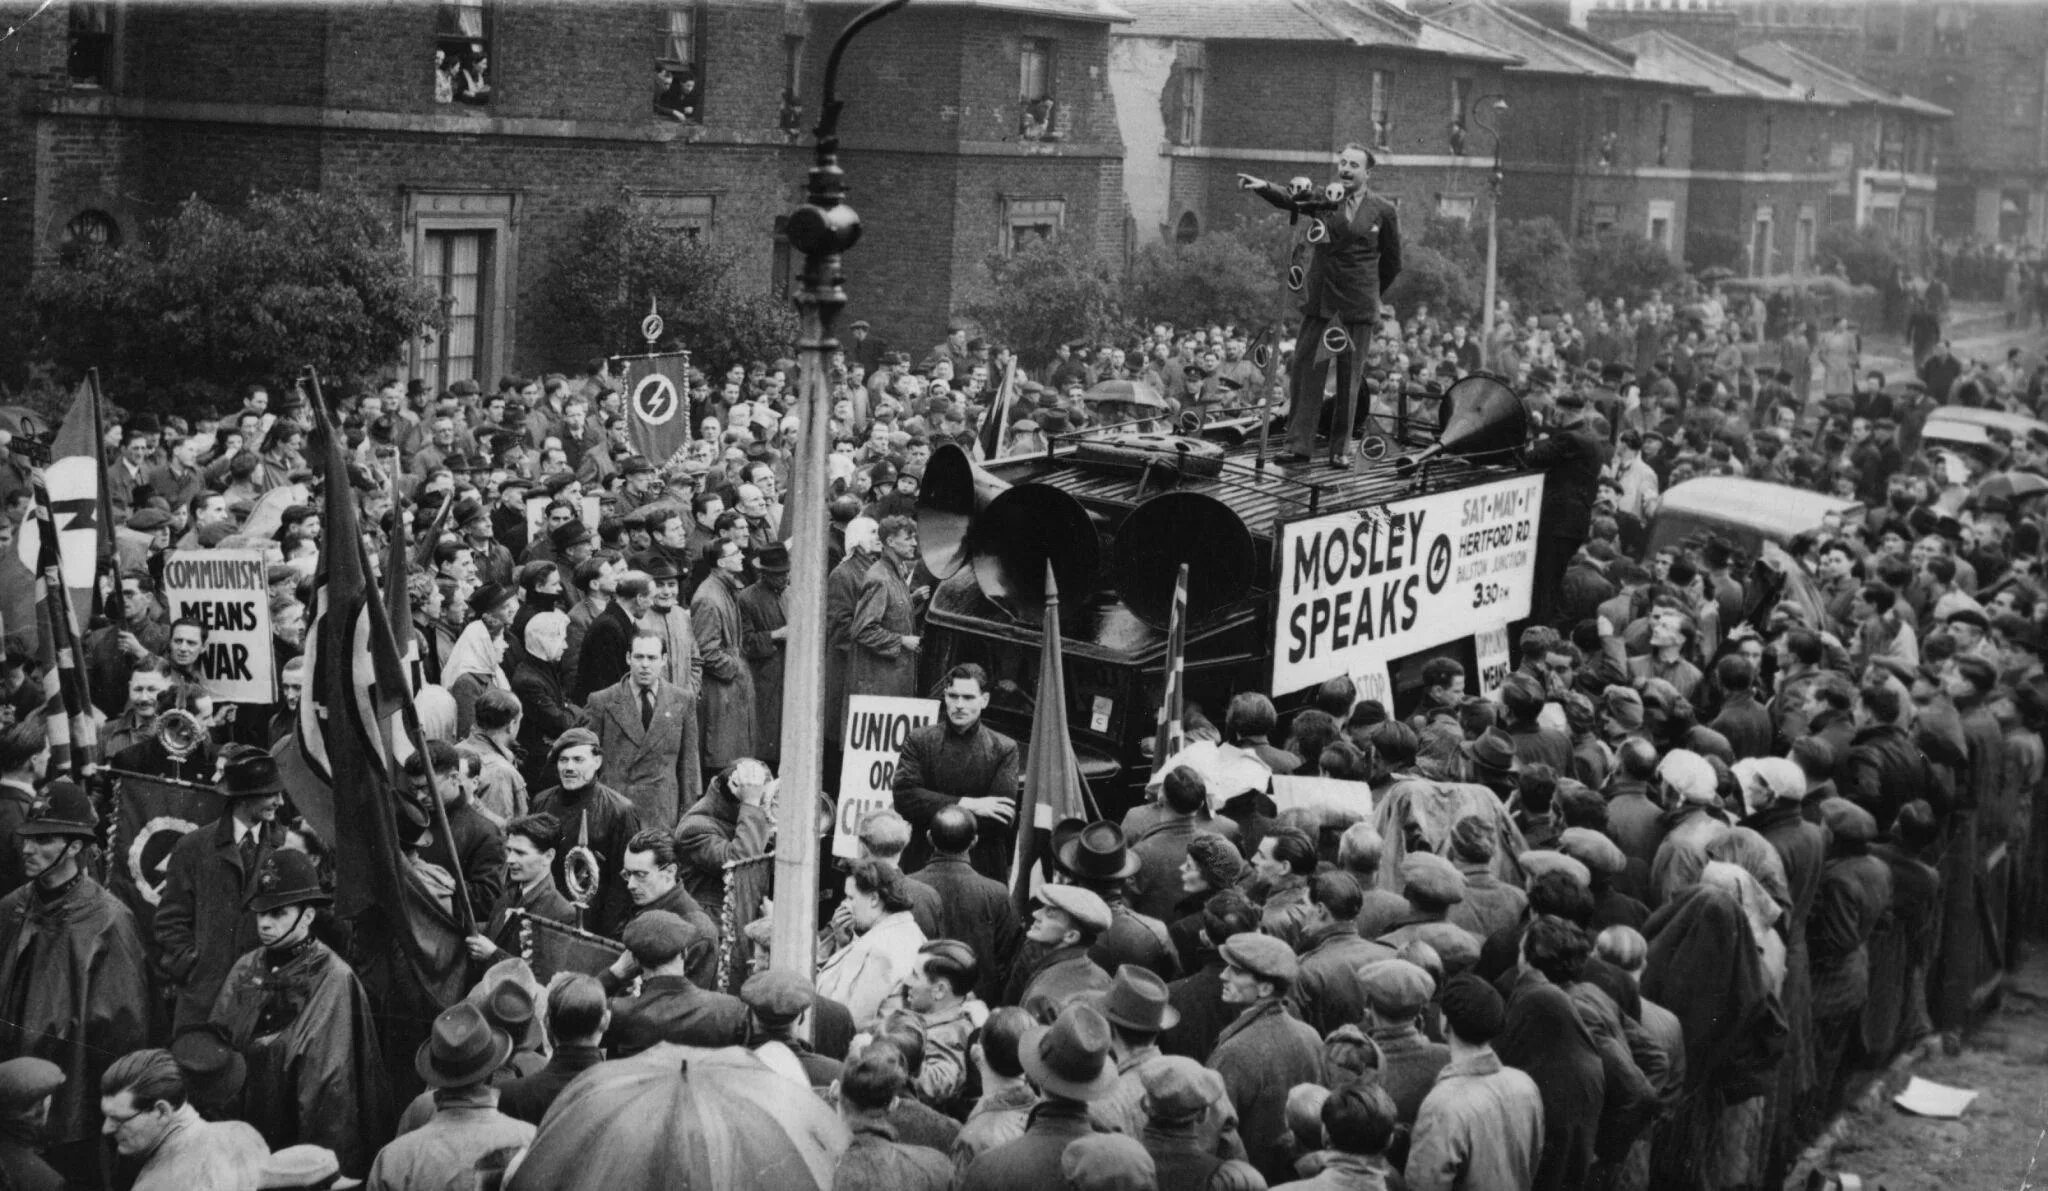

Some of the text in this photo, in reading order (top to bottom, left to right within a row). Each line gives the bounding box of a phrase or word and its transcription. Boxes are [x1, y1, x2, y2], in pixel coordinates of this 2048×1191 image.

[1293, 509, 1426, 595] MOSLEY
[1458, 524, 1513, 558] HERTFORD
[165, 560, 264, 590] COMMUNISM
[1288, 574, 1420, 664] SPEAKS
[1356, 673, 1386, 702] STOP
[869, 760, 895, 791] OR
